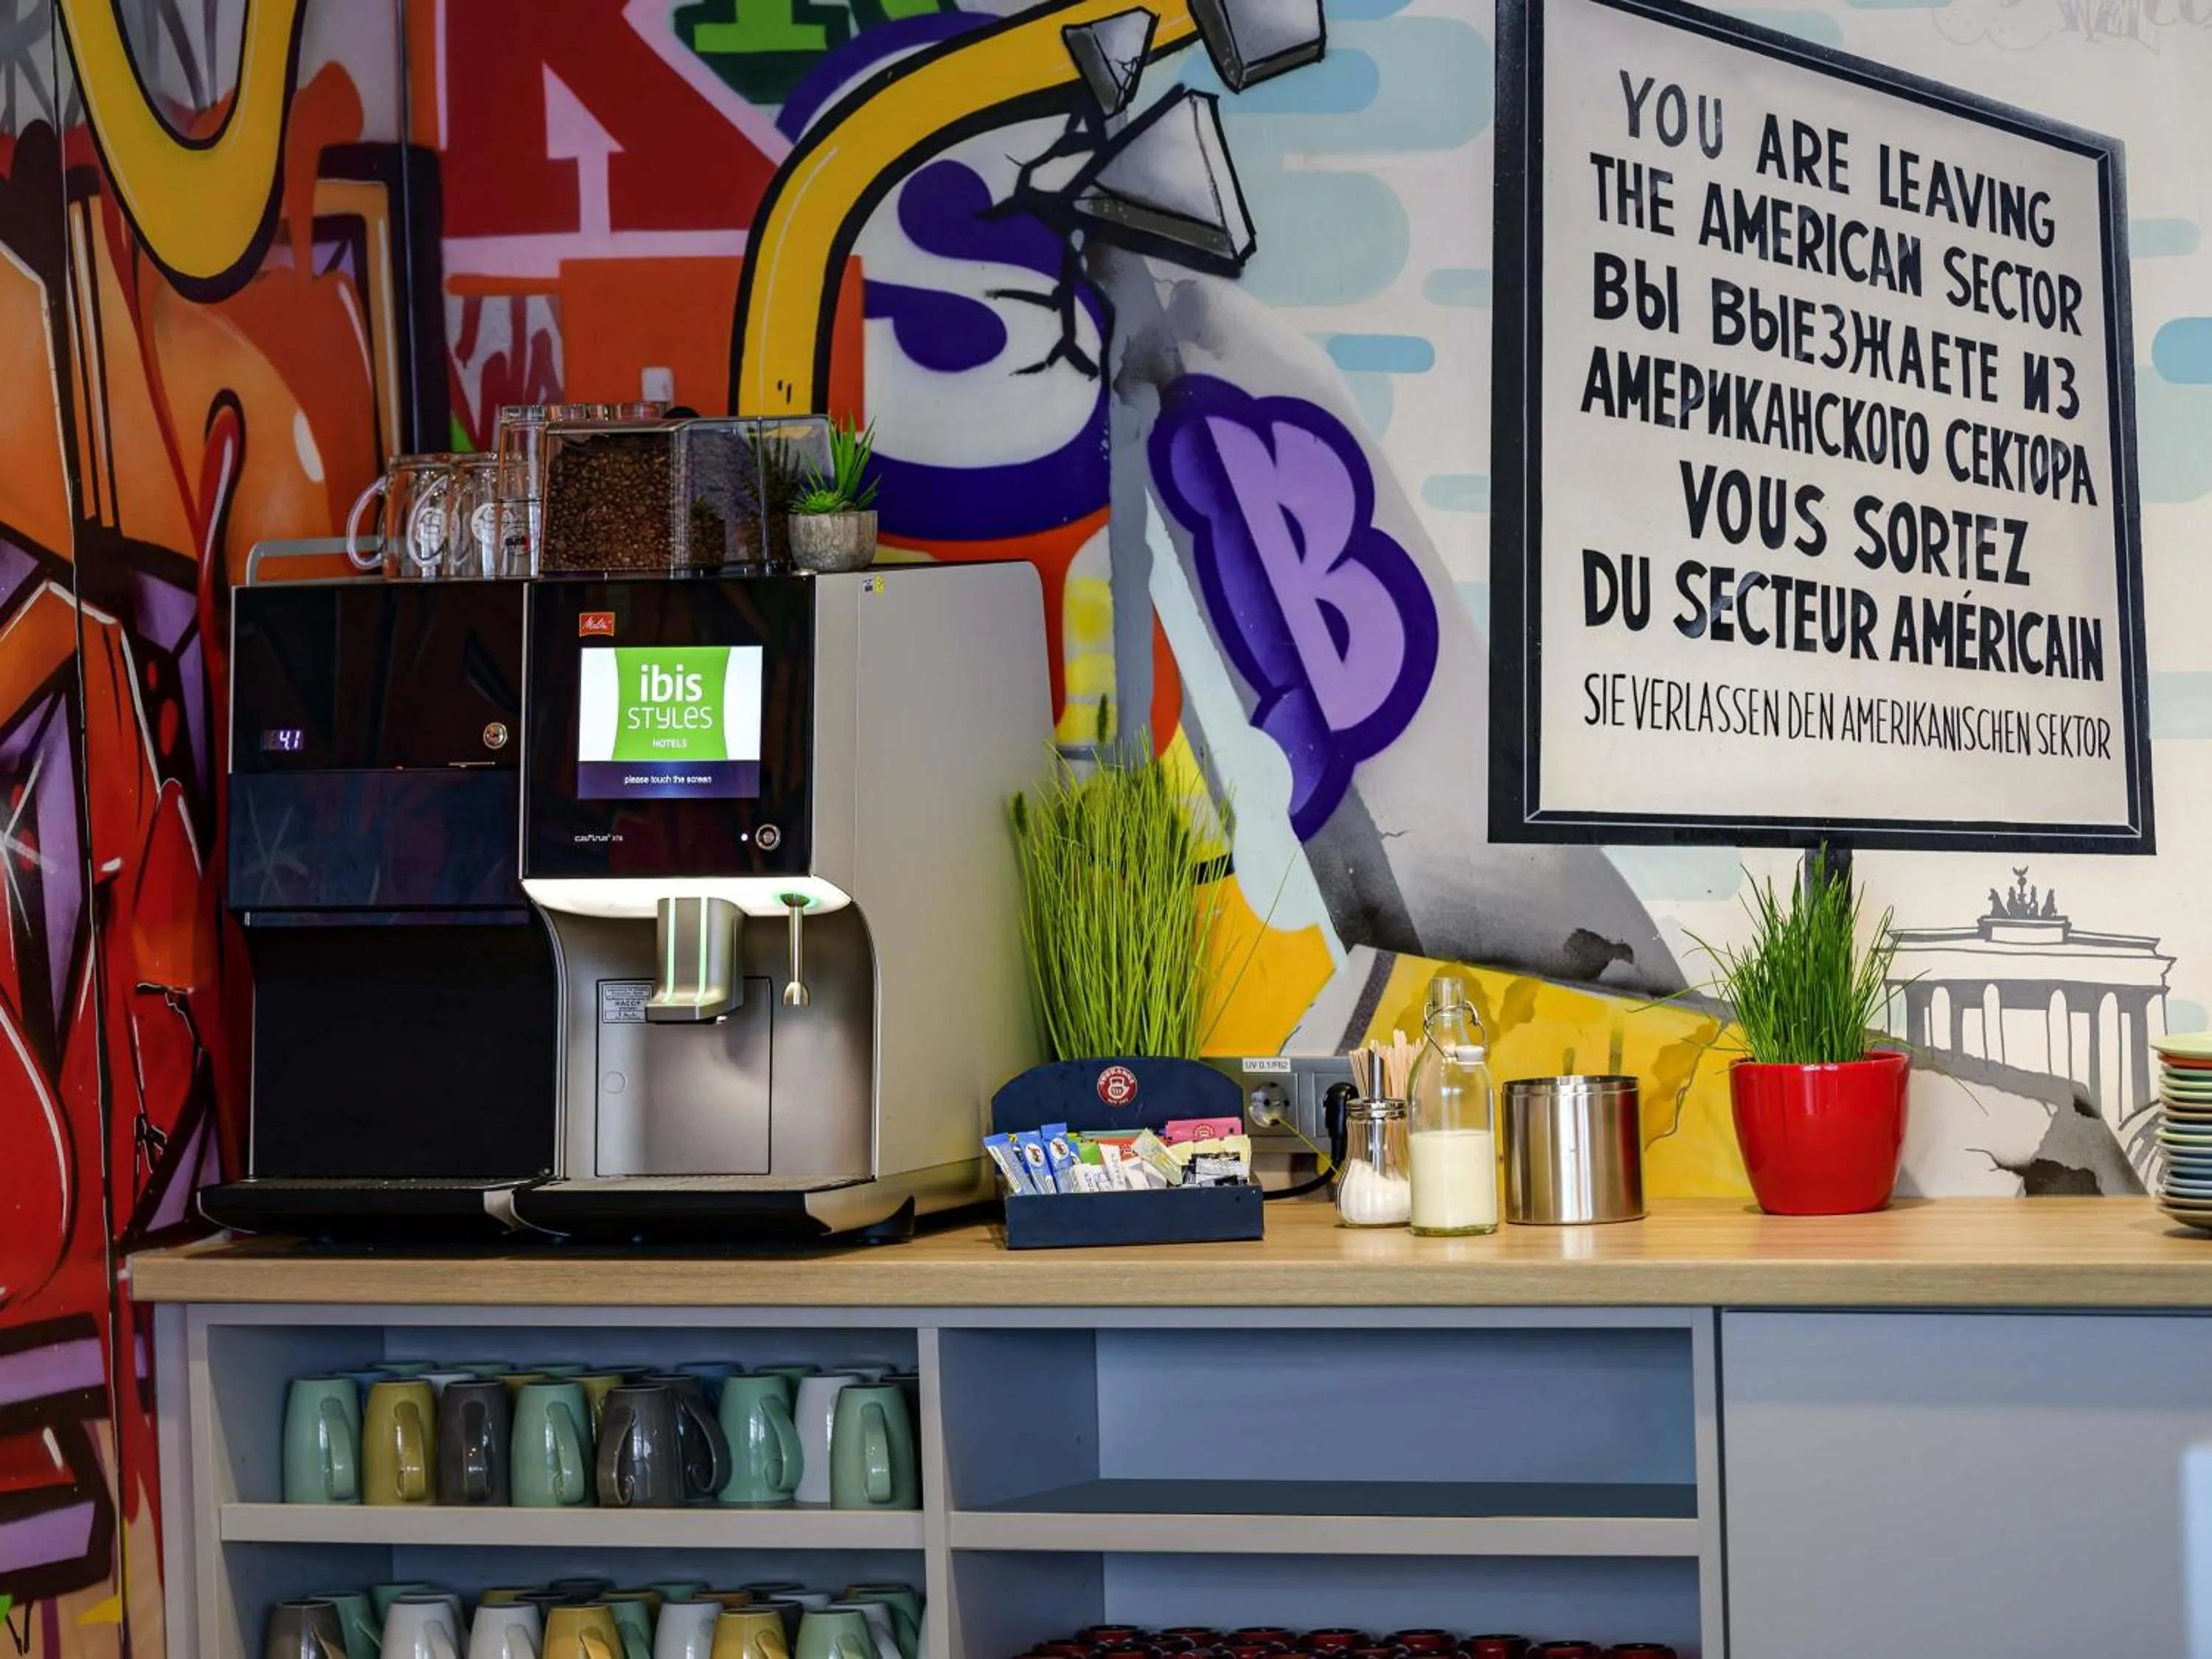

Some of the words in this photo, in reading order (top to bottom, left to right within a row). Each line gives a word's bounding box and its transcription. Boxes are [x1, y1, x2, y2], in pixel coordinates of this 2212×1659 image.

[1619, 69, 1723, 160] YOU
[1756, 112, 1850, 195] ARE
[1879, 143, 2056, 248] LEAVING
[1589, 151, 1675, 237] THE
[1698, 181, 1922, 298] AMERICAN
[1943, 246, 2083, 337] SECTOR
[1593, 251, 1680, 335] ВЫ
[1711, 276, 1998, 403] ВЫЕЗЖАЕТЕ
[2023, 350, 2080, 420] ИЗ
[1580, 345, 1930, 476] АМЕРИКАНСКОГО
[1945, 418, 2098, 507] СЕКТОРА
[1679, 459, 1828, 557] VOUS
[1853, 495, 2030, 586] SORTEZ
[1582, 548, 1651, 632] DU
[1673, 560, 1879, 661] SECTEUR
[1889, 589, 2104, 682] AMÉRICAIN
[640, 663, 703, 703] ibis
[653, 737, 687, 748] HOTELS
[1584, 673, 1627, 726] SIE
[1632, 675, 1779, 737] VERLASSEN
[1788, 691, 1834, 741] DEN
[1841, 695, 2031, 756] AMERIKANISCHEN
[2036, 713, 2111, 760] SEKTOR
[625, 774, 650, 785] please
[650, 774, 672, 784] touch
[672, 774, 685, 784] the
[686, 776, 712, 784] screen
